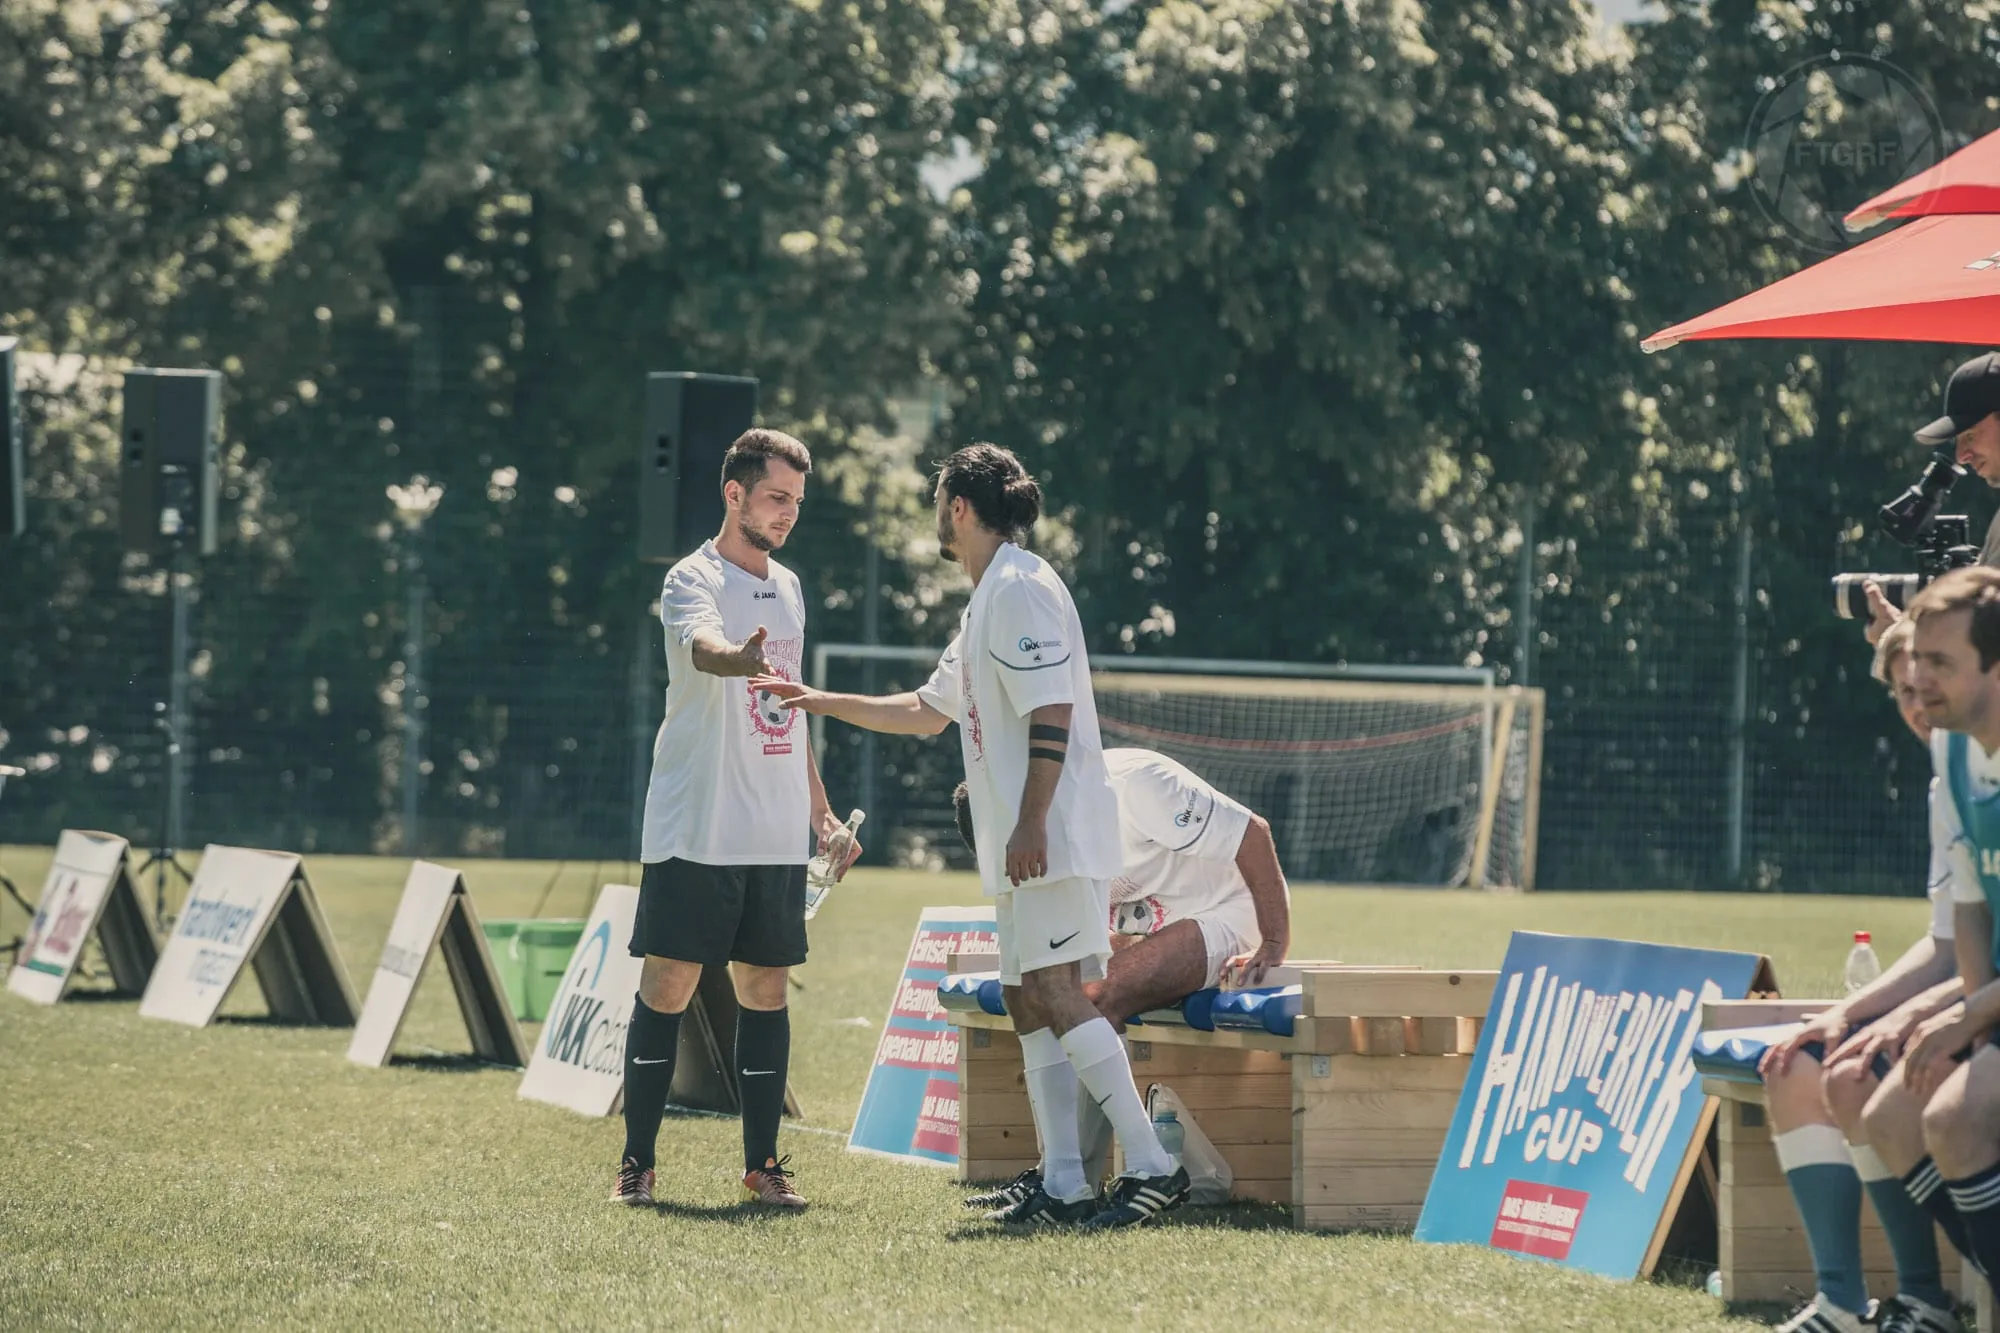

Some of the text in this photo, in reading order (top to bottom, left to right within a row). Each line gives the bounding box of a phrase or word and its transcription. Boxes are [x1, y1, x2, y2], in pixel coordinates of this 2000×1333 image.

[877, 1034, 924, 1066] genau
[1458, 965, 1723, 1194] HANDWERKER
[1523, 1107, 1604, 1166] CUP
